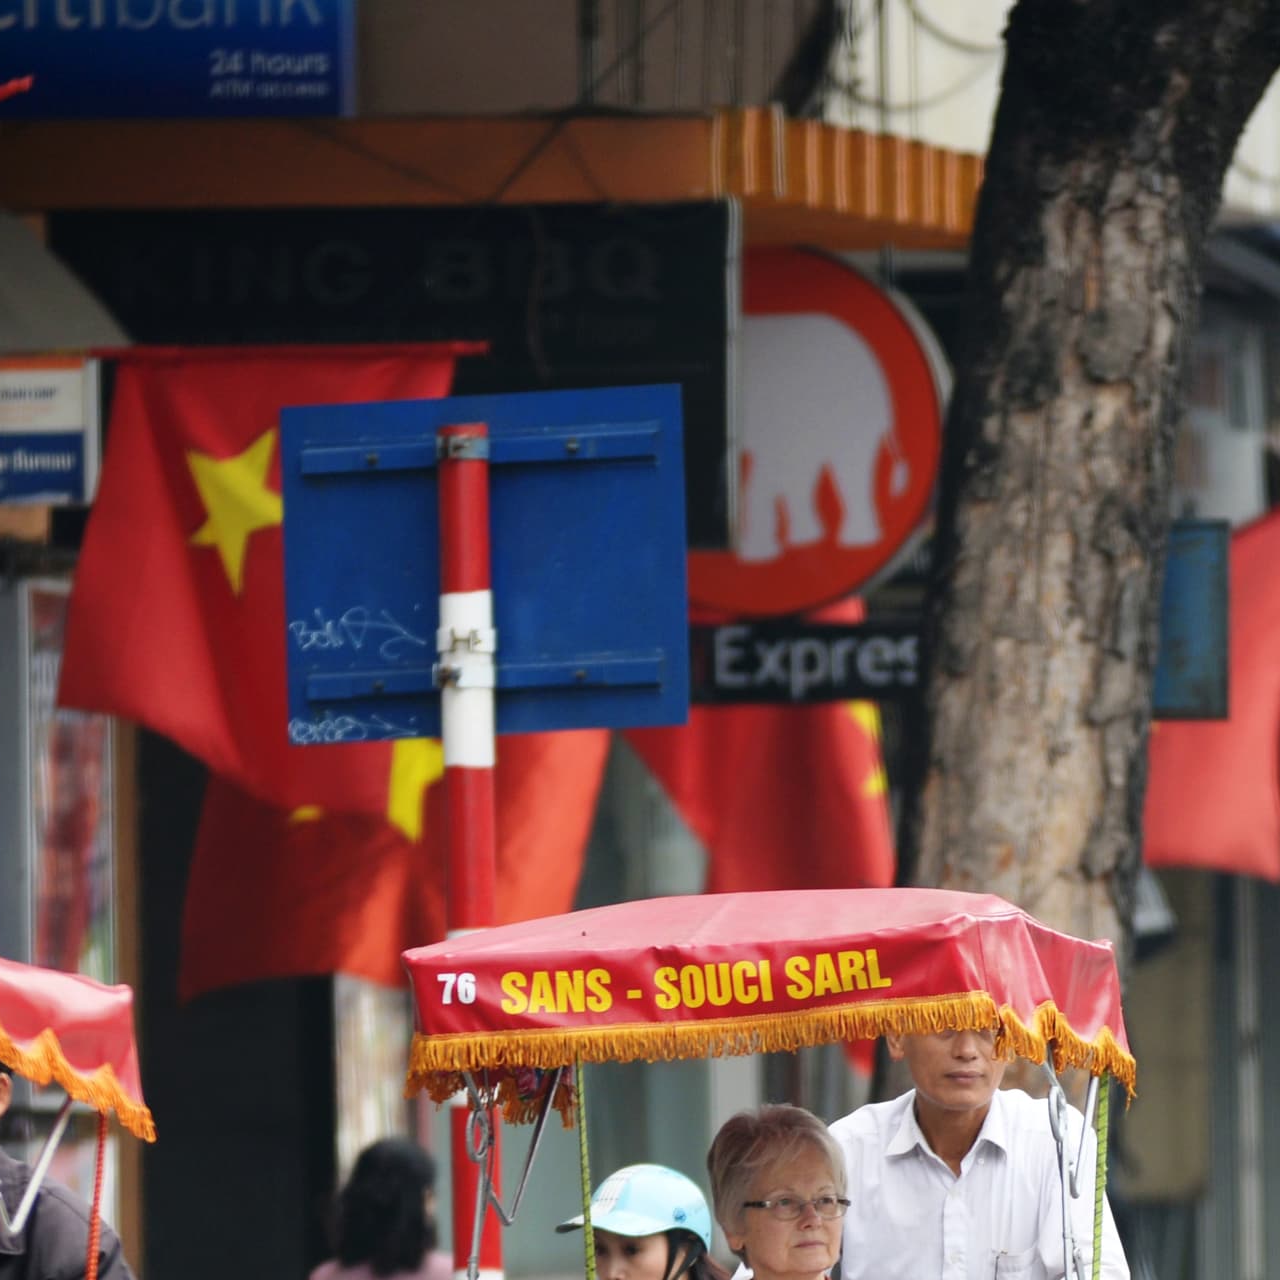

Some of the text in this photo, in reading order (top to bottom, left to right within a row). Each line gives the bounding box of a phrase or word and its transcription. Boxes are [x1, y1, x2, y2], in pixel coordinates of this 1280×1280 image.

[437, 972, 476, 1005] 76
[500, 969, 612, 1015] SANS
[653, 959, 773, 1011] SOUCI
[784, 948, 893, 1000] SARL
